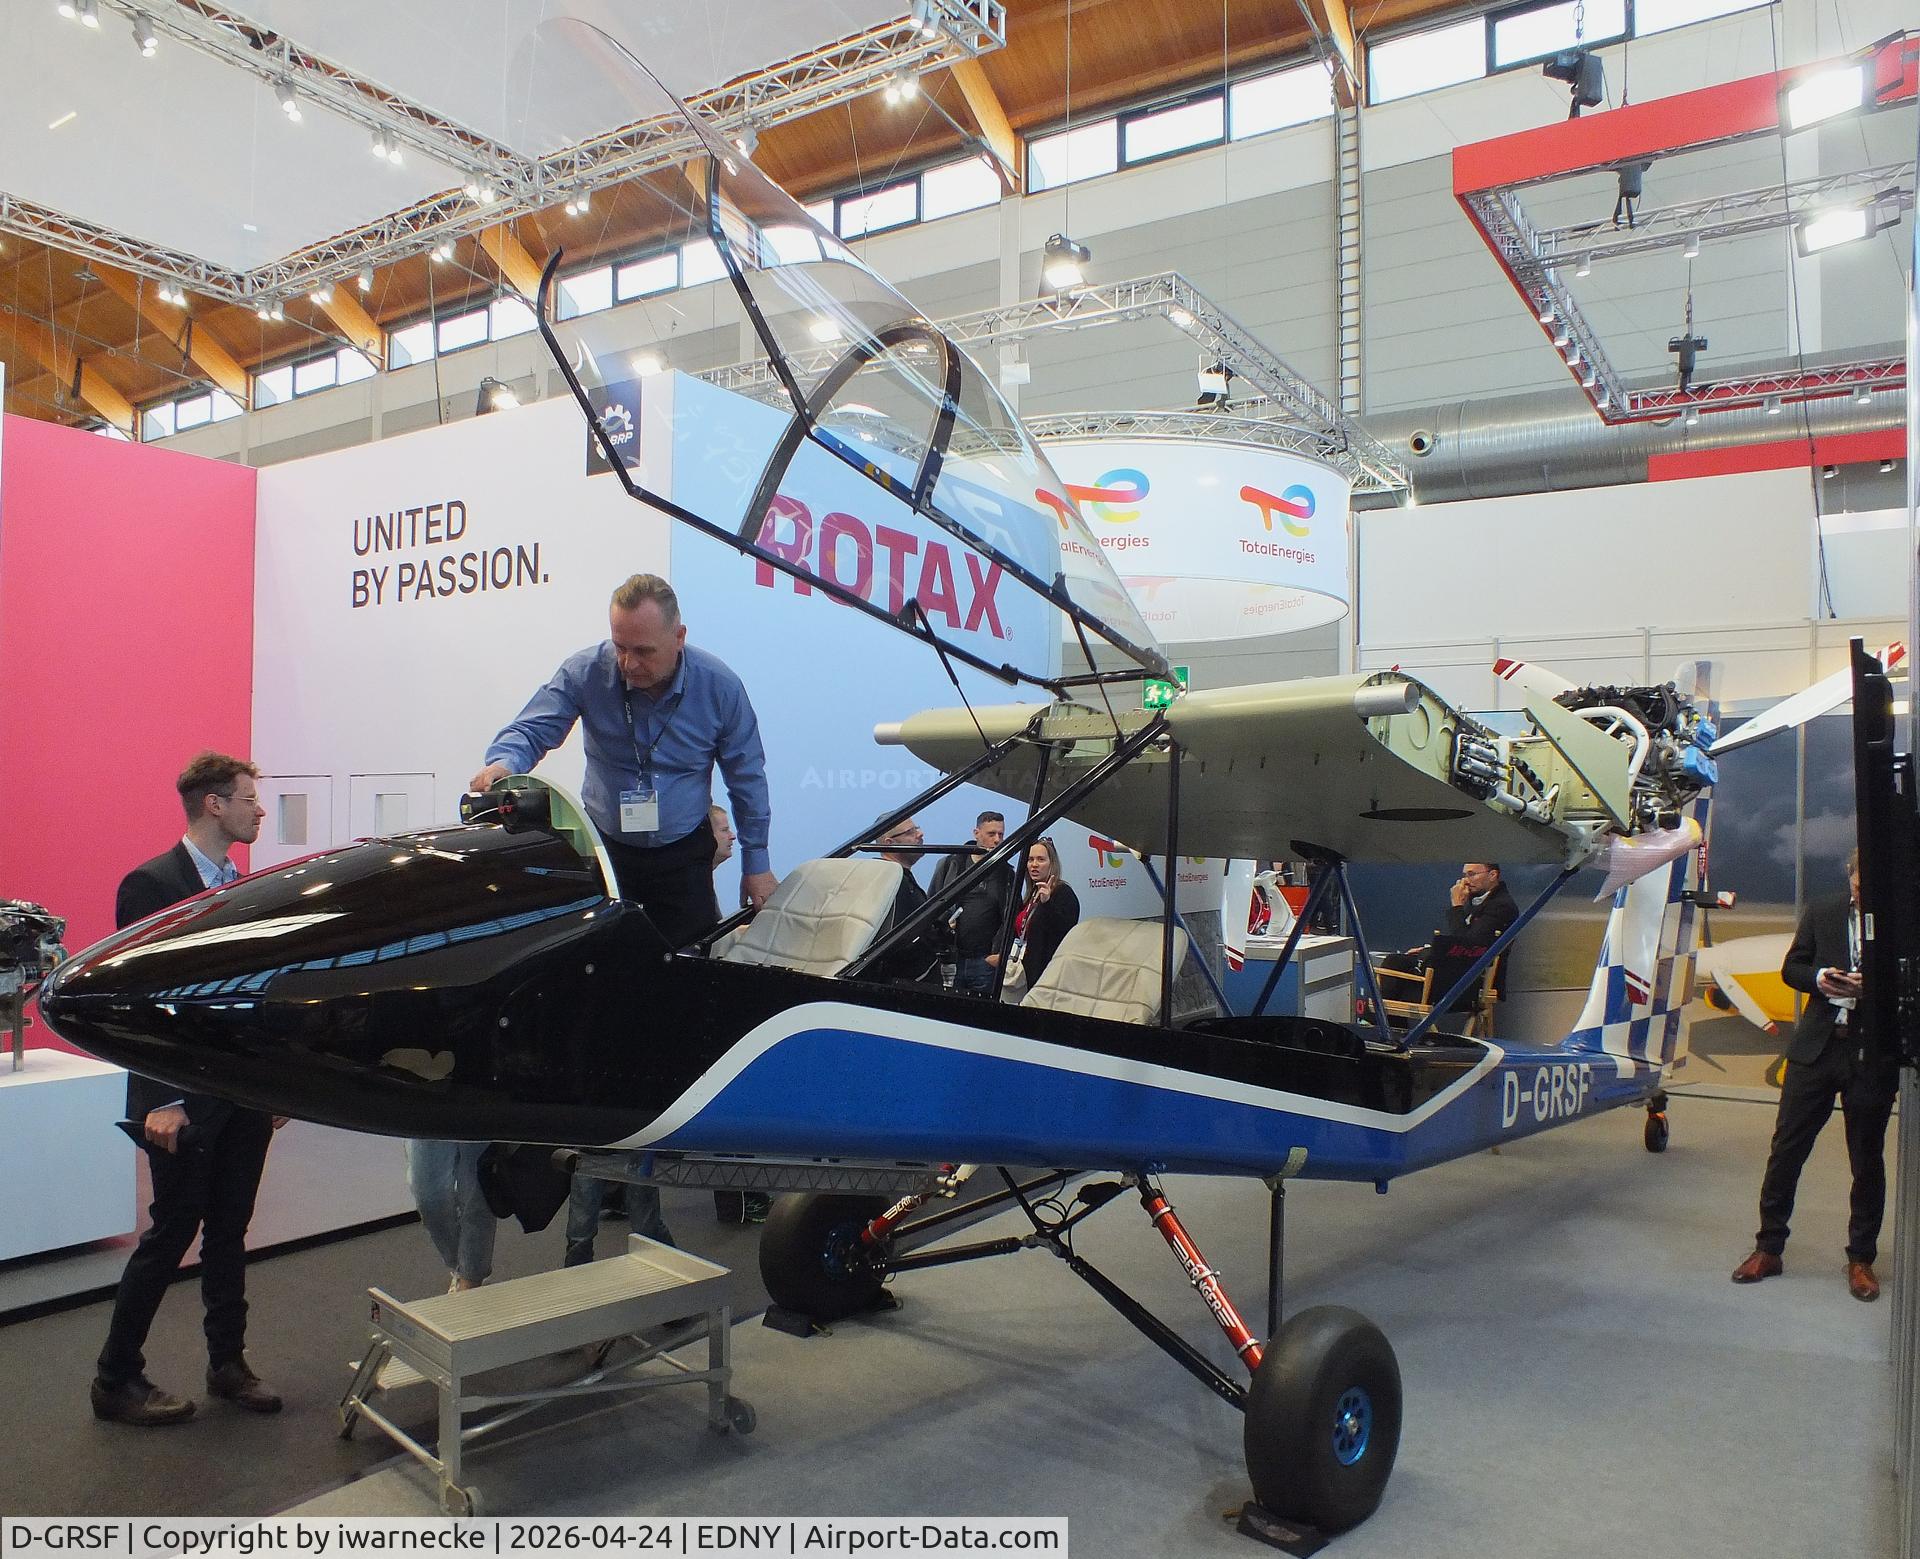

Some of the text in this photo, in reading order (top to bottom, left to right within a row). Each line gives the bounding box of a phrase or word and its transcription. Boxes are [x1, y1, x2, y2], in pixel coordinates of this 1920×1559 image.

[610, 431, 634, 446] BRP
[353, 499, 468, 557] UNITED
[1097, 533, 1150, 551] ergies
[755, 493, 1006, 640] ROTAX
[1239, 539, 1316, 564] TotalEnergies
[352, 542, 550, 608] BY PASSION.
[1088, 876, 1127, 890] TotalEnergies
[1502, 1063, 1592, 1129] D-GRSF
